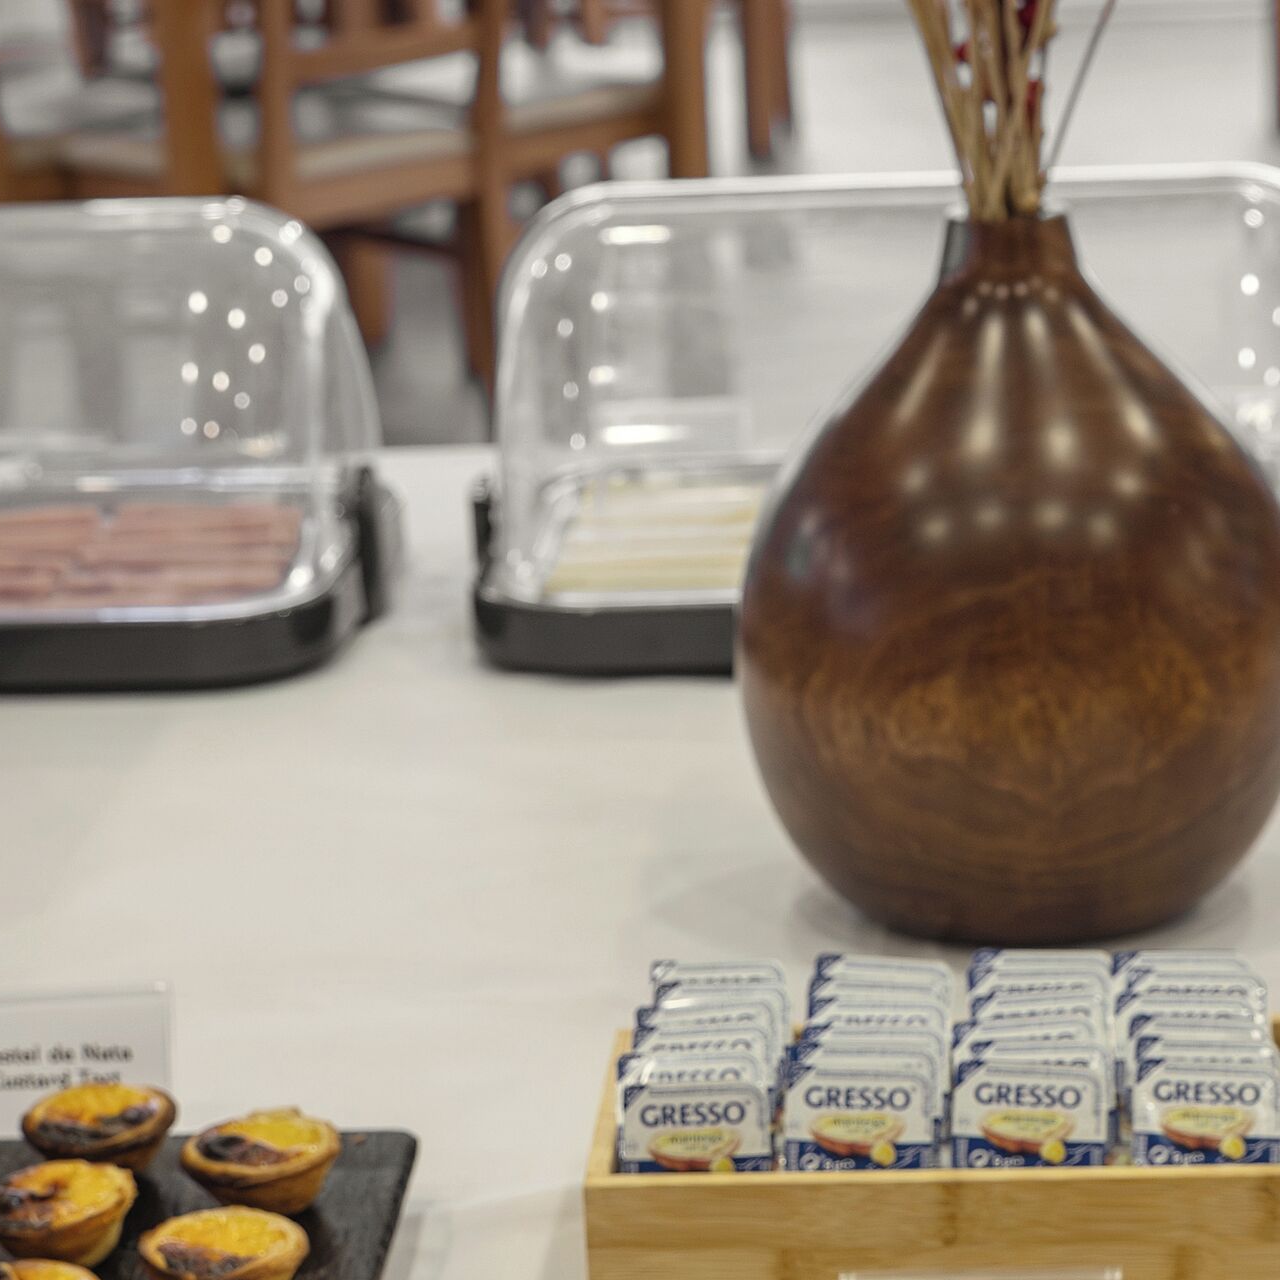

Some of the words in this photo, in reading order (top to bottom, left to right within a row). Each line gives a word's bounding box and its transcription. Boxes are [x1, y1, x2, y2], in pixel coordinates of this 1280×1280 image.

[805, 1086, 911, 1110] GRESSO
[975, 1082, 1081, 1108] GRESSO
[1153, 1080, 1261, 1105] GRESSO
[640, 1102, 746, 1126] GRESSO
